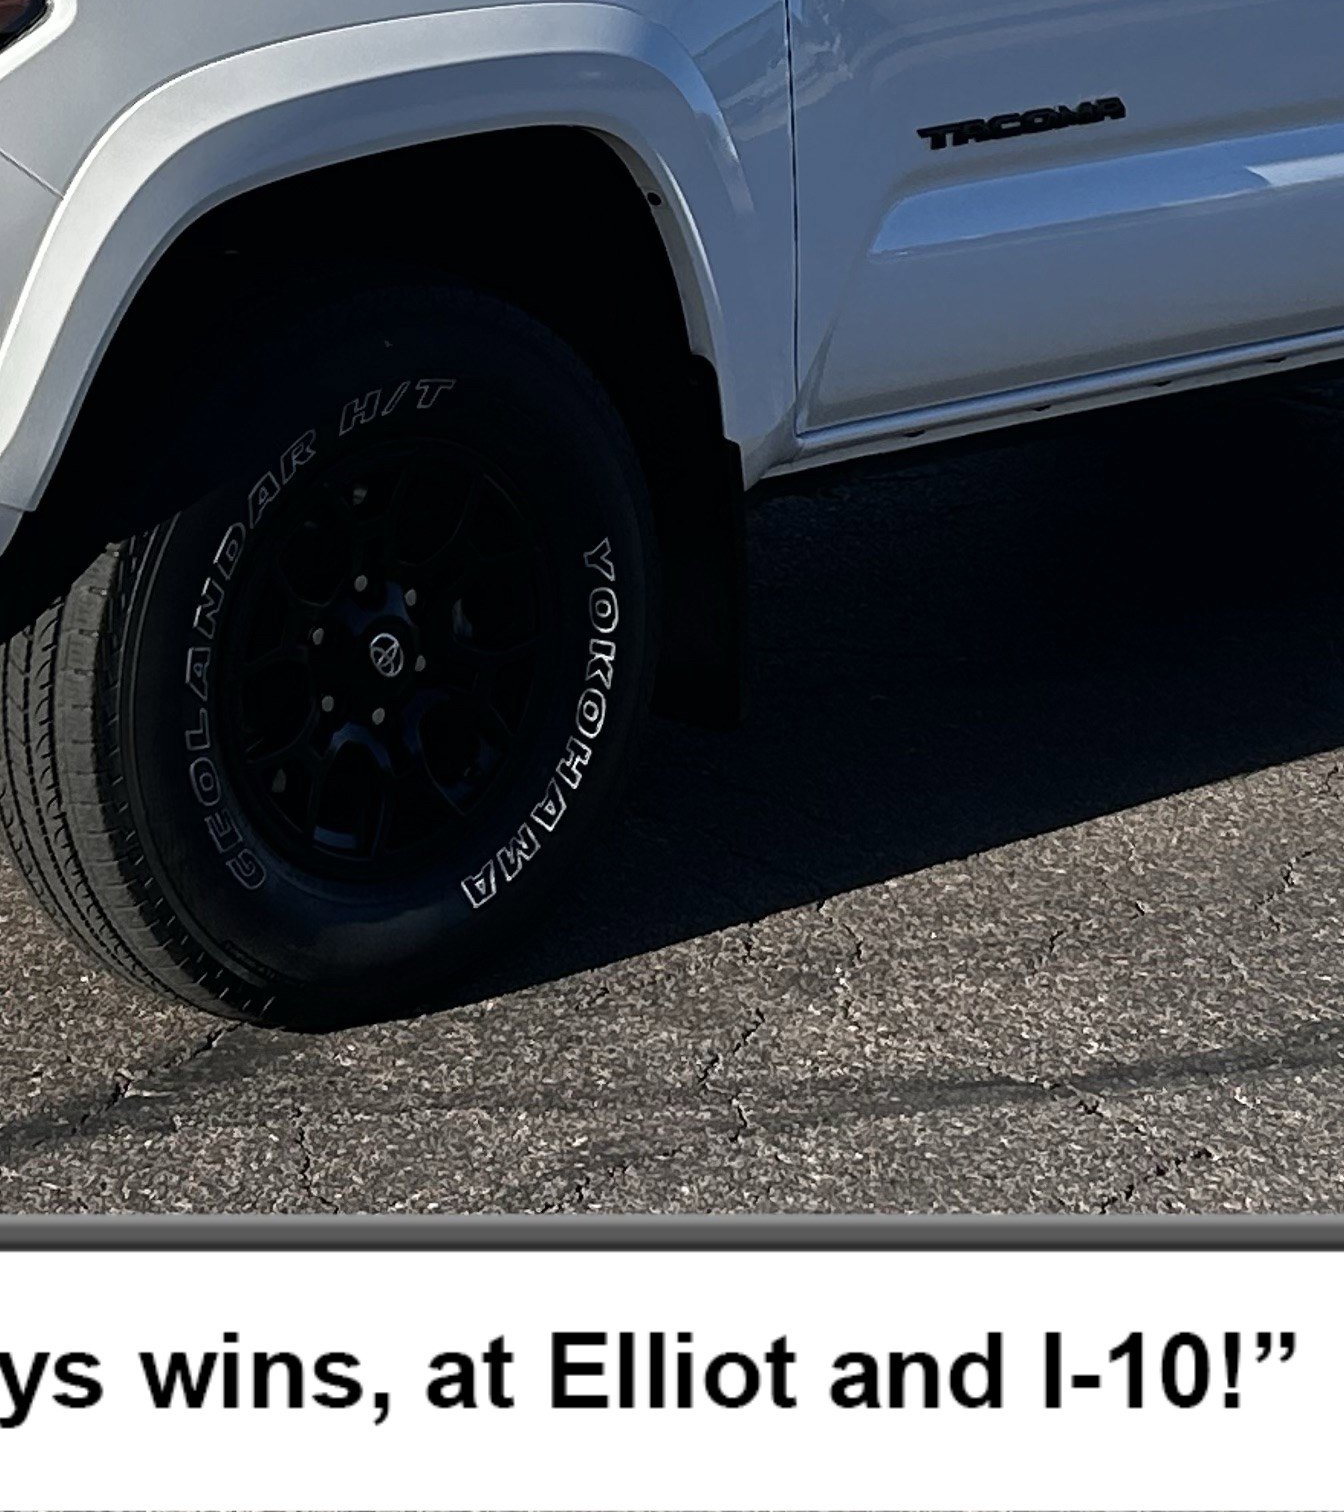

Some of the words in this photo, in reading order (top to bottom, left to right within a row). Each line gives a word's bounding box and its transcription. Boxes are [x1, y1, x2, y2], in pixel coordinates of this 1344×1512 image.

[916, 96, 1126, 150] TACOMA
[186, 428, 317, 890] GEOLANDAR
[339, 378, 456, 436] H/T
[460, 537, 619, 909] YOKOHAMA
